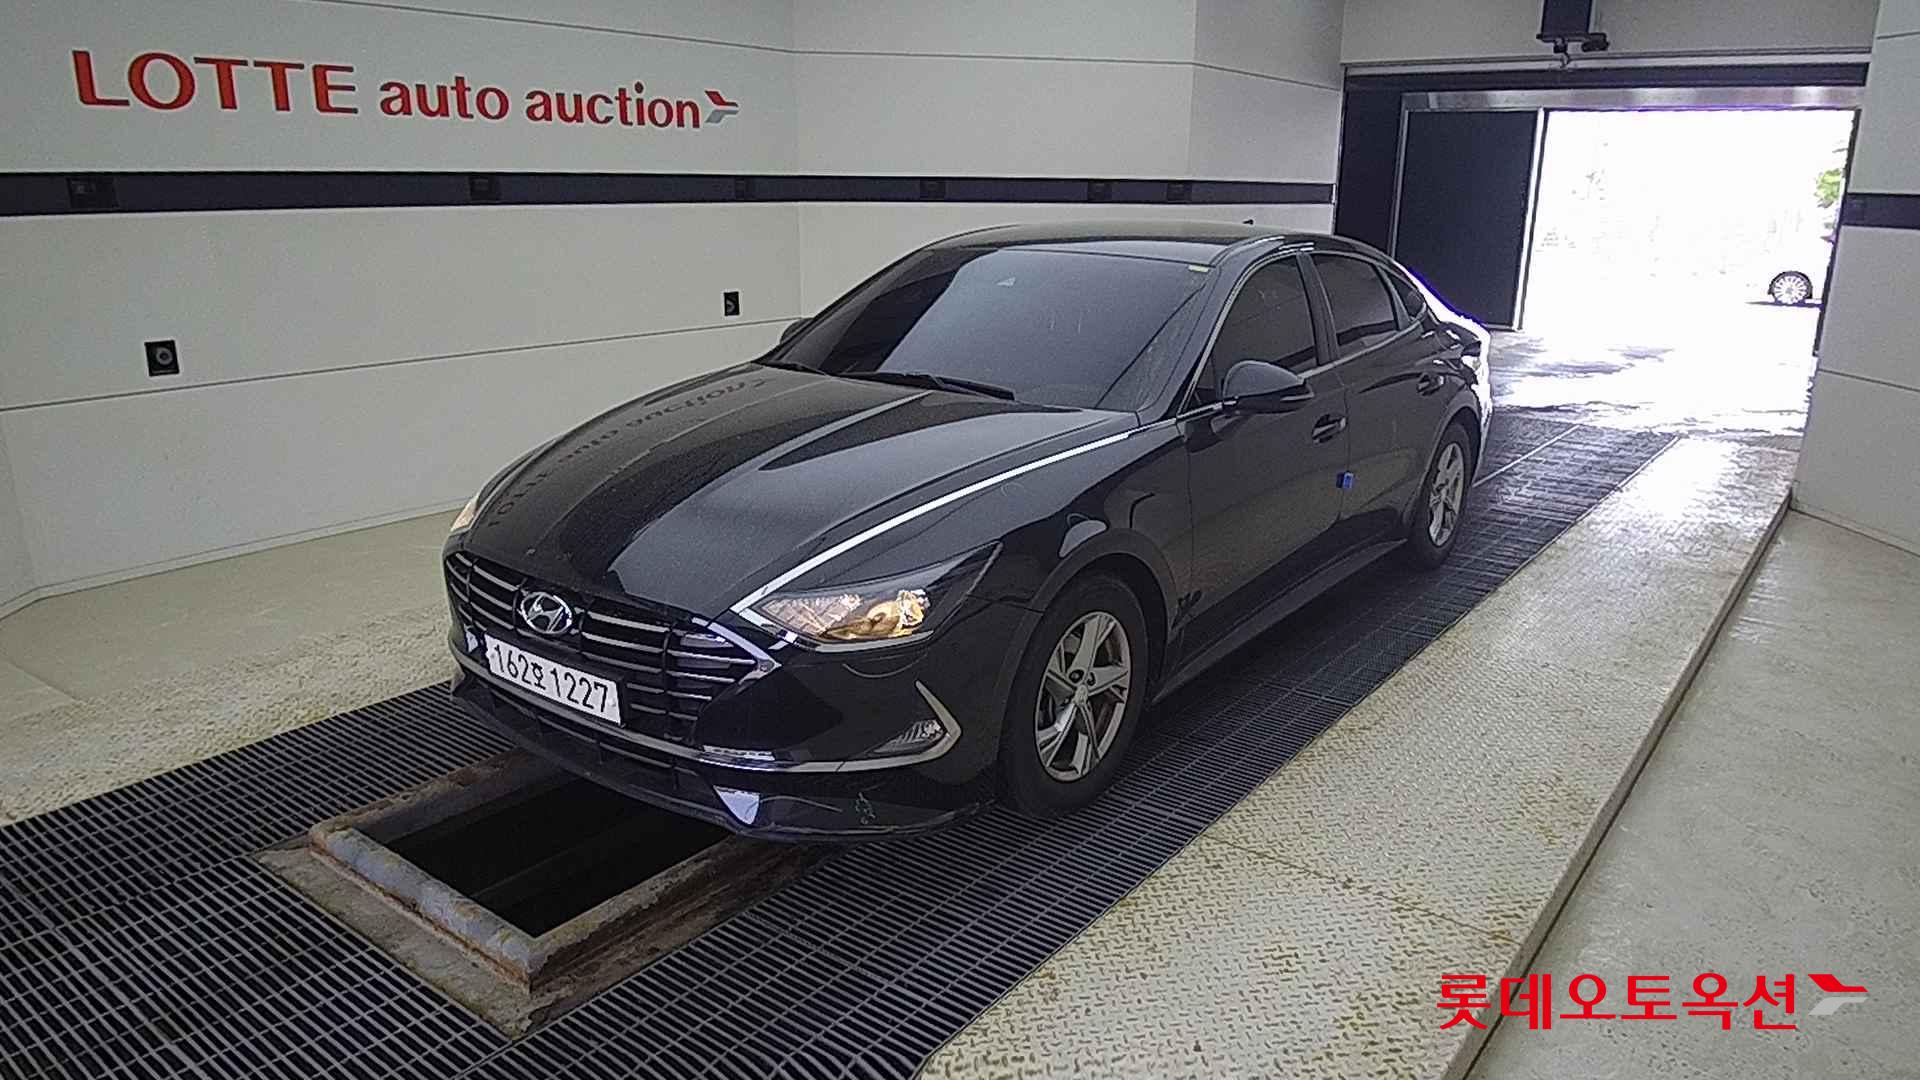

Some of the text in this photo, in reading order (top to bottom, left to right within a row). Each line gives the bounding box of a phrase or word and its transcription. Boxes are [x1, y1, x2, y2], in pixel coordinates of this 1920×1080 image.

[73, 50, 701, 129] LOTTE auto auction
